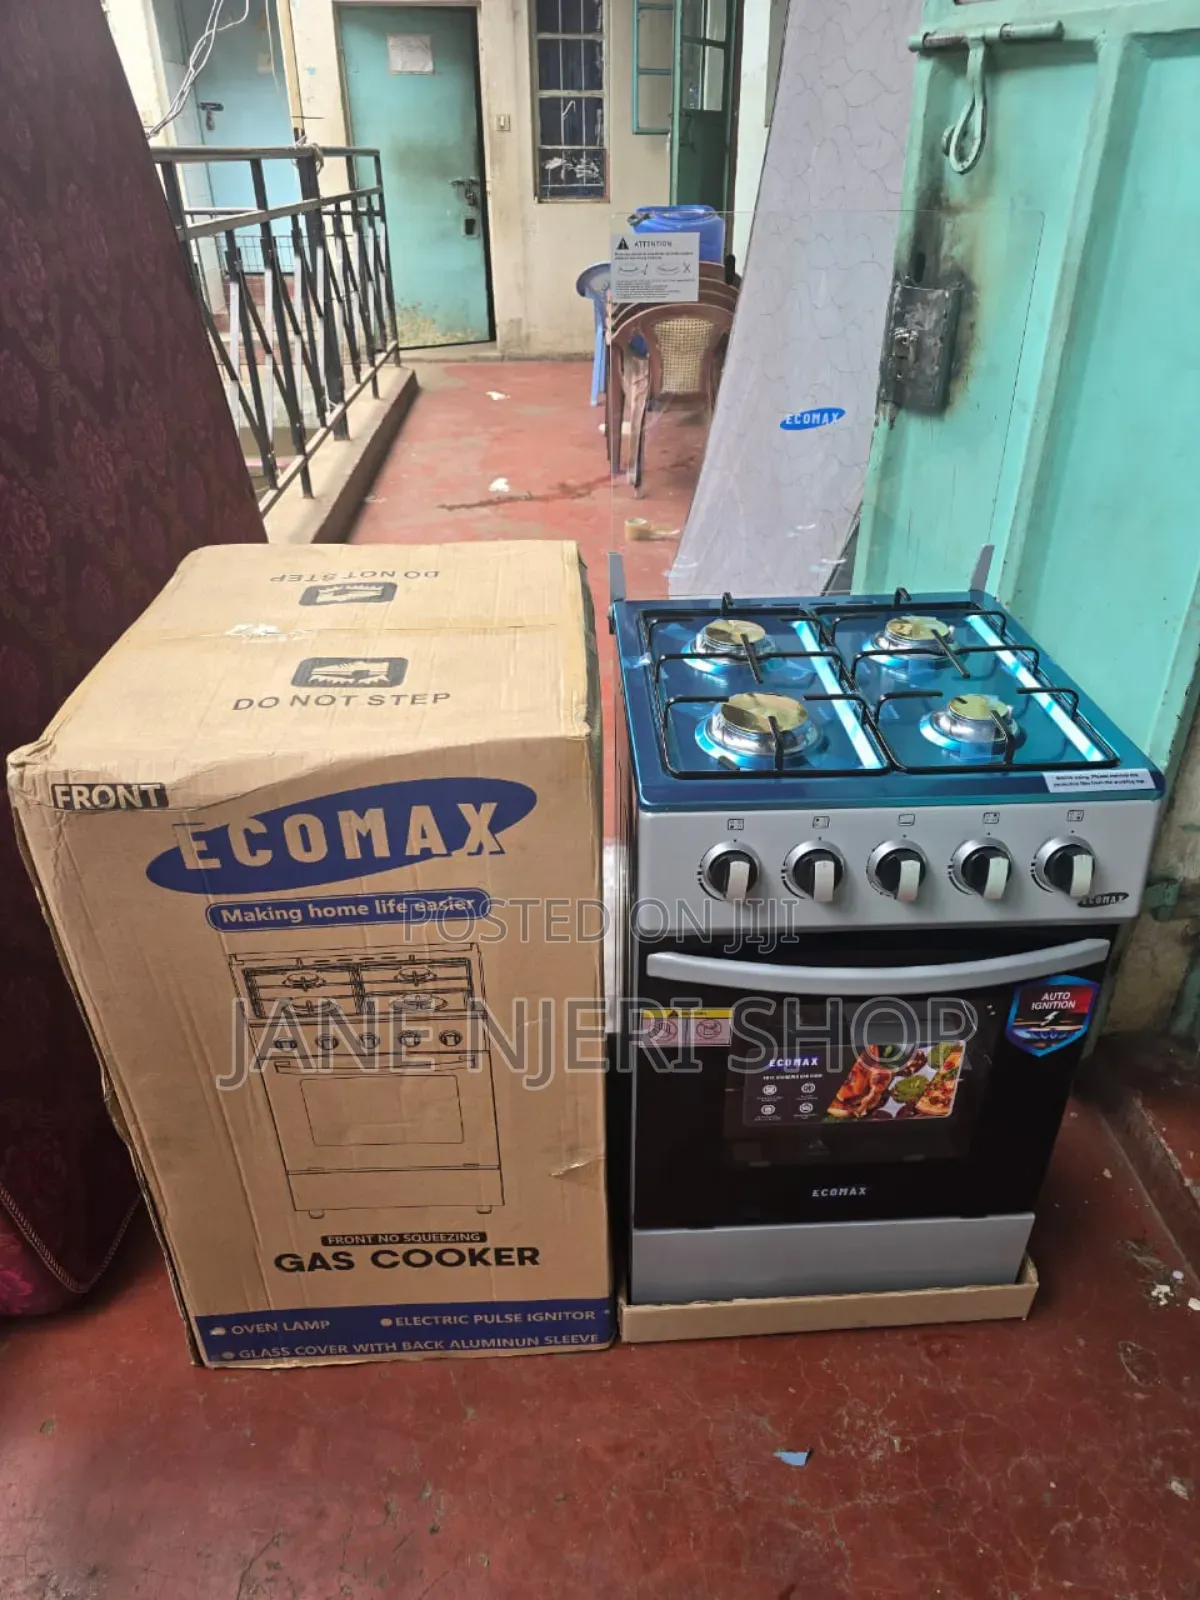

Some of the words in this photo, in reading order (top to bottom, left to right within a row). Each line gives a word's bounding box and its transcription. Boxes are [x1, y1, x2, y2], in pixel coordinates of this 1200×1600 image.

[634, 240, 673, 248] ATTENTION
[785, 411, 840, 425] ECOMAX
[270, 573, 336, 582] STEP
[343, 570, 396, 580] NOT
[404, 570, 440, 579] DO
[232, 696, 280, 711] DO
[289, 694, 359, 708] NOT
[367, 692, 451, 706] STEP
[54, 783, 162, 810] FRONT
[171, 802, 506, 870] ECOMAX
[220, 907, 304, 924] Making
[308, 903, 369, 919] home
[375, 899, 409, 915] life
[414, 895, 476, 912] easier
[1041, 991, 1071, 1001] AUTO
[1030, 1000, 1076, 1011] IGNITION
[769, 1057, 819, 1067] ECOMAX
[811, 1186, 867, 1198] ECOMAX
[327, 1235, 374, 1245] FRONT
[378, 1234, 400, 1244] NO
[403, 1232, 481, 1243] SQUEEZING
[273, 1250, 356, 1273] GAS
[370, 1247, 541, 1269] COOKER
[395, 1314, 469, 1327] ELECTRIC
[473, 1312, 522, 1325] PULSE
[527, 1310, 596, 1322] IGNITOR
[231, 1322, 278, 1335] OVEN
[282, 1319, 331, 1331] LAMP
[238, 1346, 291, 1359] GLASS
[294, 1344, 348, 1356] COVER
[352, 1341, 397, 1353] WITH
[402, 1339, 444, 1351] BACK
[544, 1333, 599, 1345] SLEEVE
